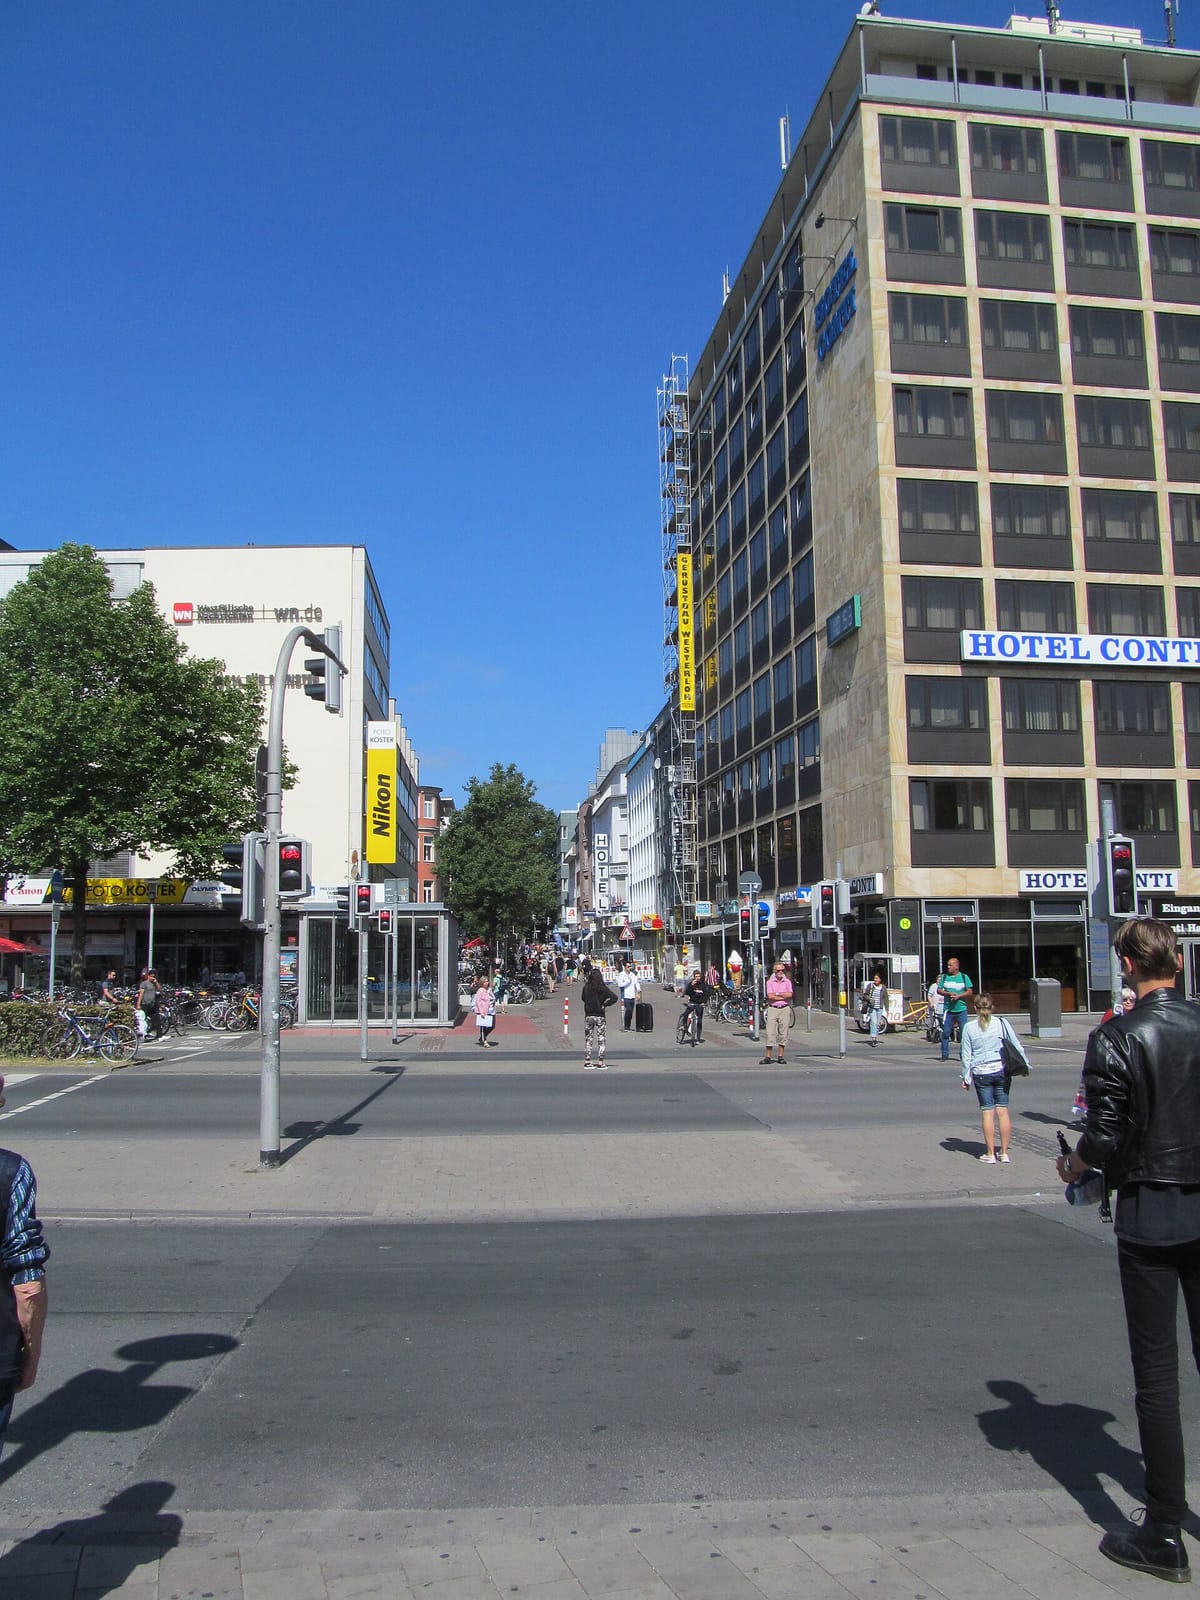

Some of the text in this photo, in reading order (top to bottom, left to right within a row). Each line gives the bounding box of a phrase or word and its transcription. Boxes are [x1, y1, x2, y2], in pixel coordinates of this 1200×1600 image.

[174, 610, 191, 619] WN
[274, 603, 322, 622] wn.de
[969, 633, 1090, 660] HOTEL
[372, 773, 391, 837] Nikon
[597, 835, 606, 909] HOTEL
[851, 877, 876, 893] CONTI
[1025, 873, 1173, 888] HOTE NTI
[10, 887, 43, 895] Canon
[86, 882, 177, 897] FOTO KÖTER
[1161, 903, 1200, 915] Eingan
